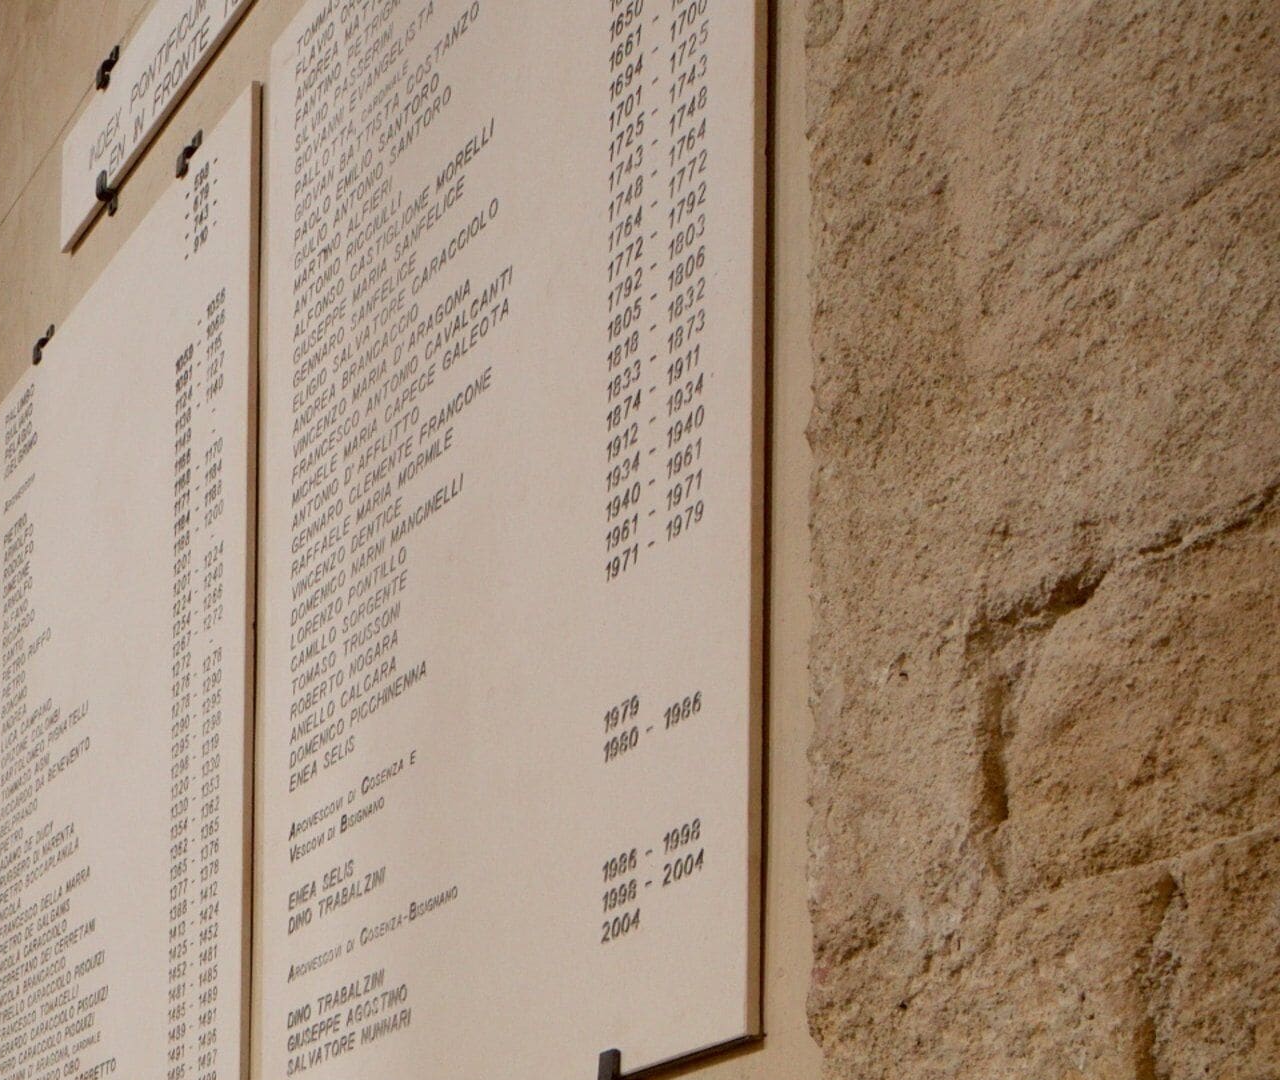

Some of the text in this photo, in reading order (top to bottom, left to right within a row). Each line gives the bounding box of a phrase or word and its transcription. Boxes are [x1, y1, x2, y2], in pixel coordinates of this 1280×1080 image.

[151, 16, 210, 117] FRONTE
[294, 5, 480, 222] GIOVAN BATTISTA COSTANZO
[608, 54, 708, 163] 1725 1743
[609, 19, 709, 133] 1701 1725
[88, 106, 122, 170] INDEX
[608, 85, 708, 192] 1743 1748
[608, 117, 706, 223] 1748 1764
[293, 118, 495, 342] ALFONSO CASTIGLIONE MORELLI
[607, 180, 707, 283] 1772 1792
[608, 148, 708, 253] 1764 1772
[292, 175, 465, 365] GIUSEPPE MARIA SANFELICE
[292, 198, 499, 413] ELIGIO SALVATORE CARACCIOLO
[292, 251, 417, 388] GENNARO SANFELICE
[607, 245, 706, 343] 1805 1806
[291, 265, 513, 485] FRANCESCO ANTONIO CAVALCANTI
[291, 298, 509, 508] MICHELE MARIA CAPECE GALEOTA
[606, 308, 706, 403] 1833 1873
[290, 427, 453, 580] RAFFAELE MARIA MORMILE
[291, 366, 492, 554] GENNARO CLEMENTE FRANCONE
[605, 468, 703, 553] 1961 1971
[290, 473, 464, 627] DOMENICO NARNI MANCINELLI
[290, 546, 407, 651] LORENZO PONTILLO
[290, 569, 408, 673] CAMILLO SORGENTE
[289, 629, 398, 721] ROBERTO NOGARA
[289, 656, 397, 746] ANIELLO CALCARA
[289, 661, 427, 769] DOMENICO PICCHINENNA
[288, 735, 355, 793] ENEA SELIS
[602, 848, 705, 913] 1998 2004
[286, 1008, 412, 1077] SALVATORE NUNNARI
[287, 984, 408, 1053] GIUSEPPE AGOSTINO
